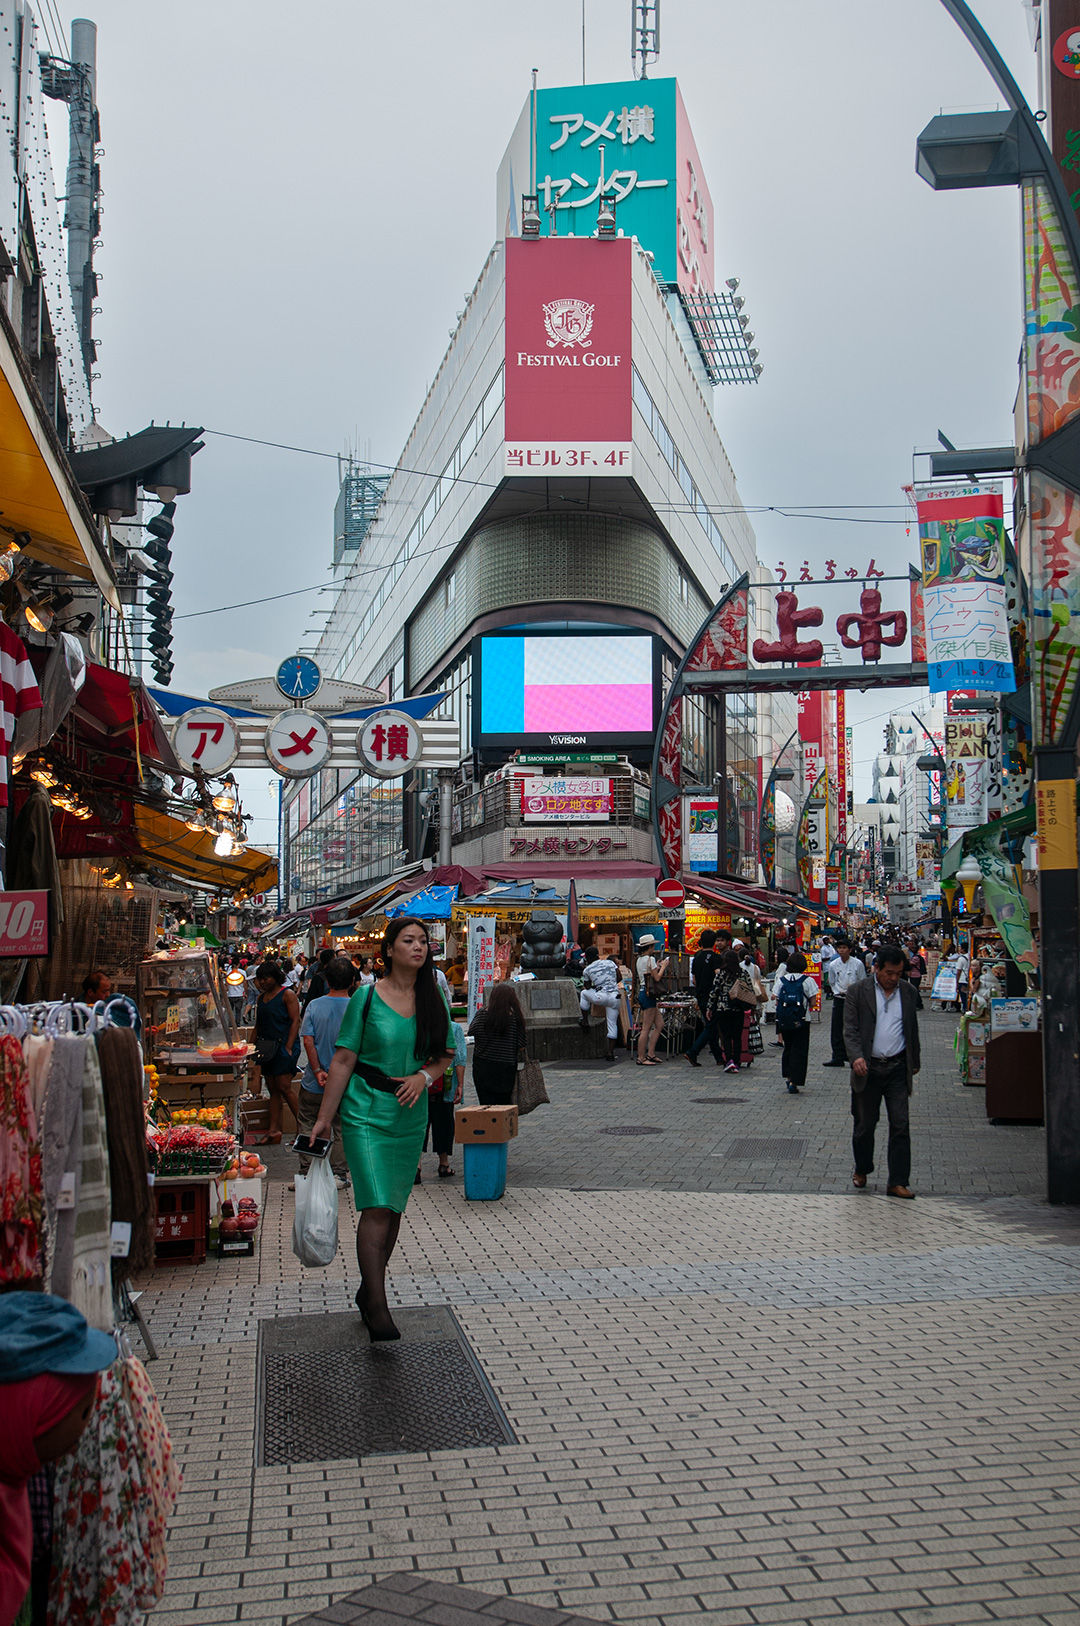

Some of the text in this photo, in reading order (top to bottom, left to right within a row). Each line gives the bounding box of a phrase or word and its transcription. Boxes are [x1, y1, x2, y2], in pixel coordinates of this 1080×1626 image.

[549, 104, 656, 152] アメ横
[537, 169, 669, 210] センター
[516, 352, 621, 366] FESTIVAL GOLF
[753, 588, 907, 663] 上中
[187, 722, 410, 761] アメ横
[531, 780, 604, 794] アメ横女学園
[546, 799, 605, 810] ロケ地です
[510, 837, 627, 855] アメ横センター
[707, 915, 730, 923] KEBAB
